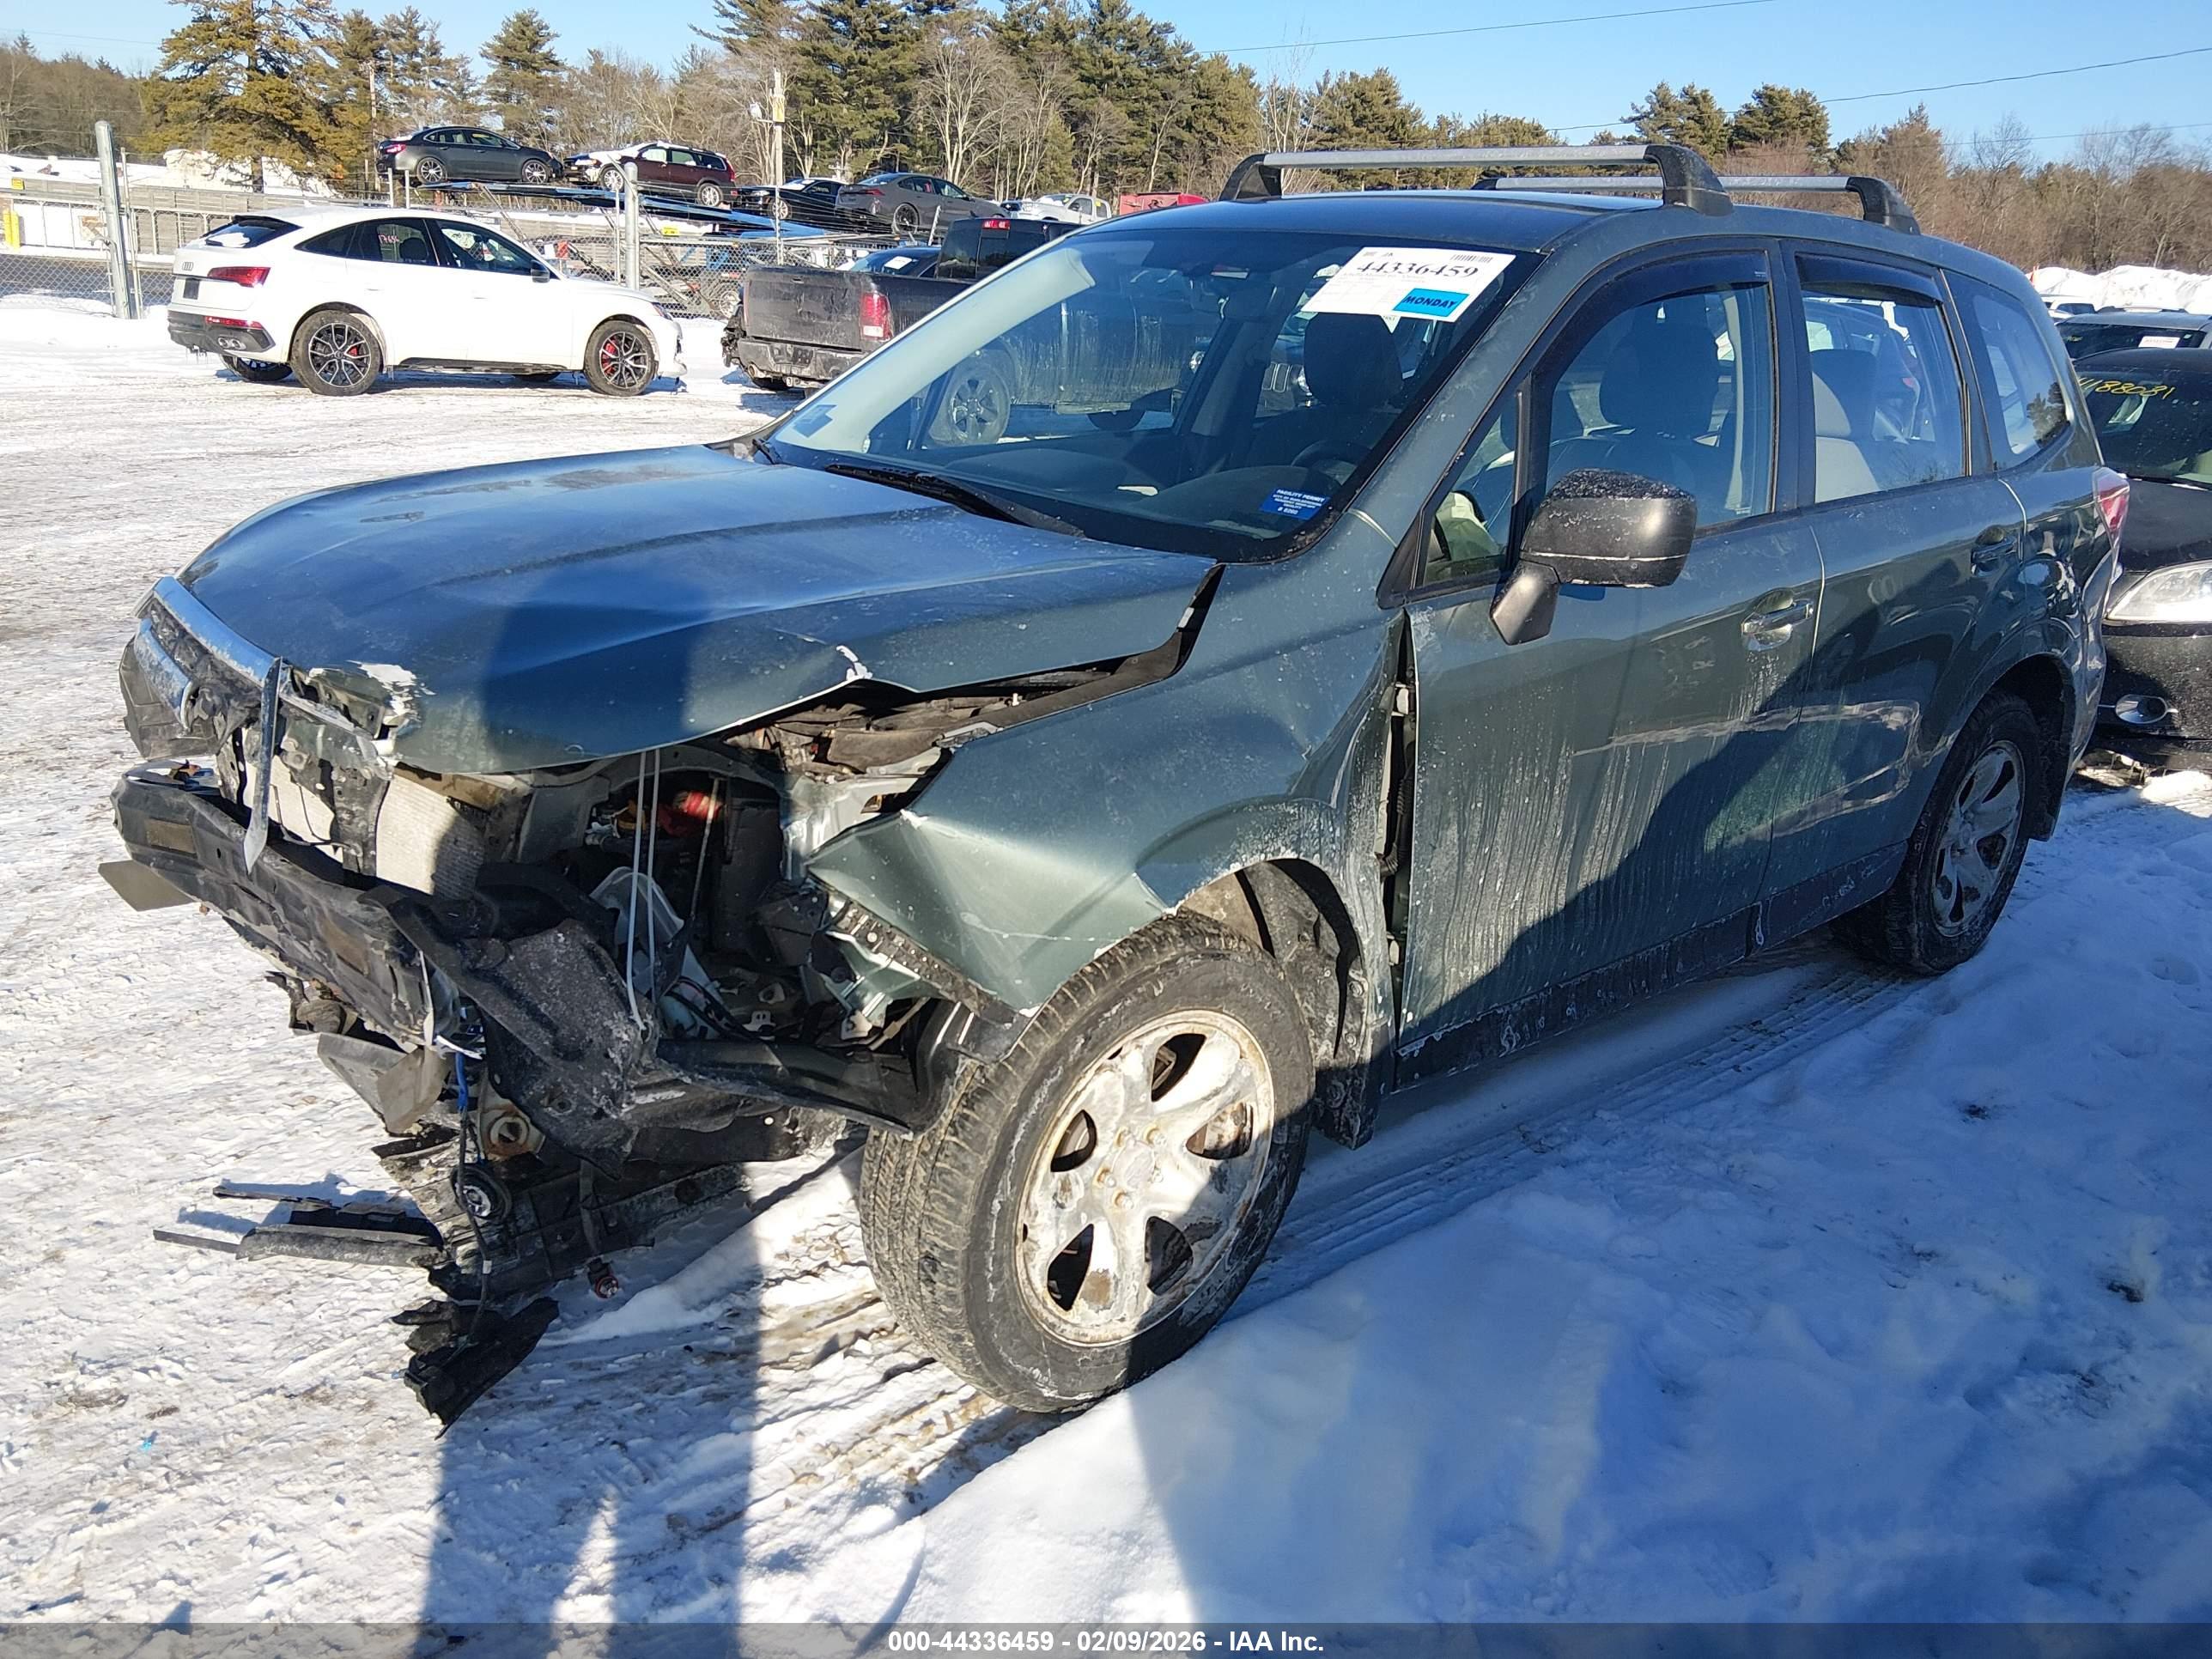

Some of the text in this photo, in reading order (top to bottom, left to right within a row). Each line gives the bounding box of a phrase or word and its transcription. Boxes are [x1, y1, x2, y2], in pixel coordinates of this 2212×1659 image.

[1357, 261, 1479, 277] 44336459
[1402, 296, 1457, 310] MONDAY
[1303, 494, 1325, 502] PERMIT
